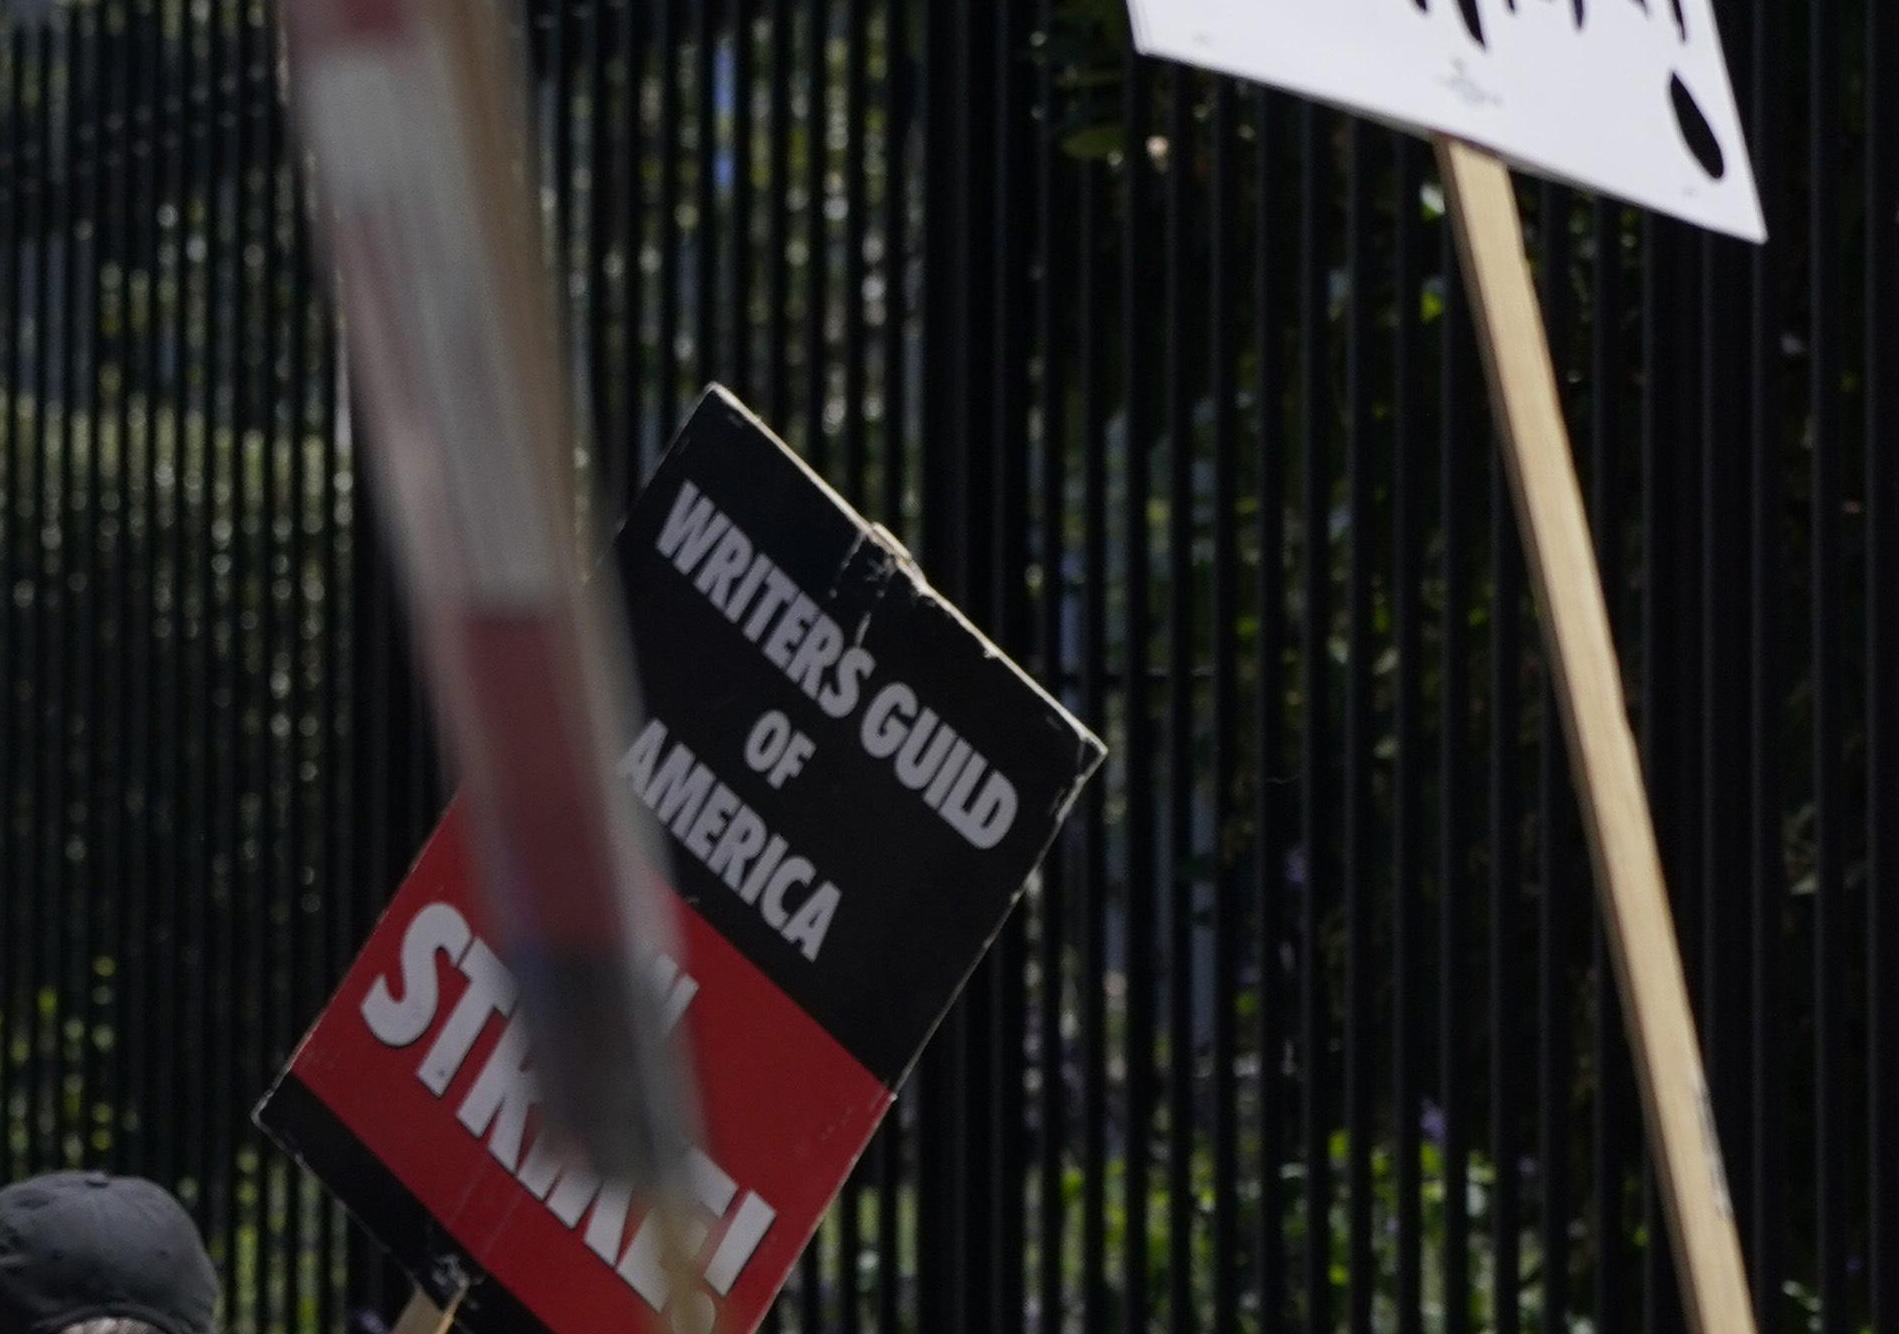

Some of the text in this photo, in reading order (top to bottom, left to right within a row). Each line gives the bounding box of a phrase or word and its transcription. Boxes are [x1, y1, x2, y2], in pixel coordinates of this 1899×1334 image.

[654, 480, 1021, 849] WRITERS GUILD
[743, 710, 817, 789] OF
[616, 718, 843, 963] AMERICA
